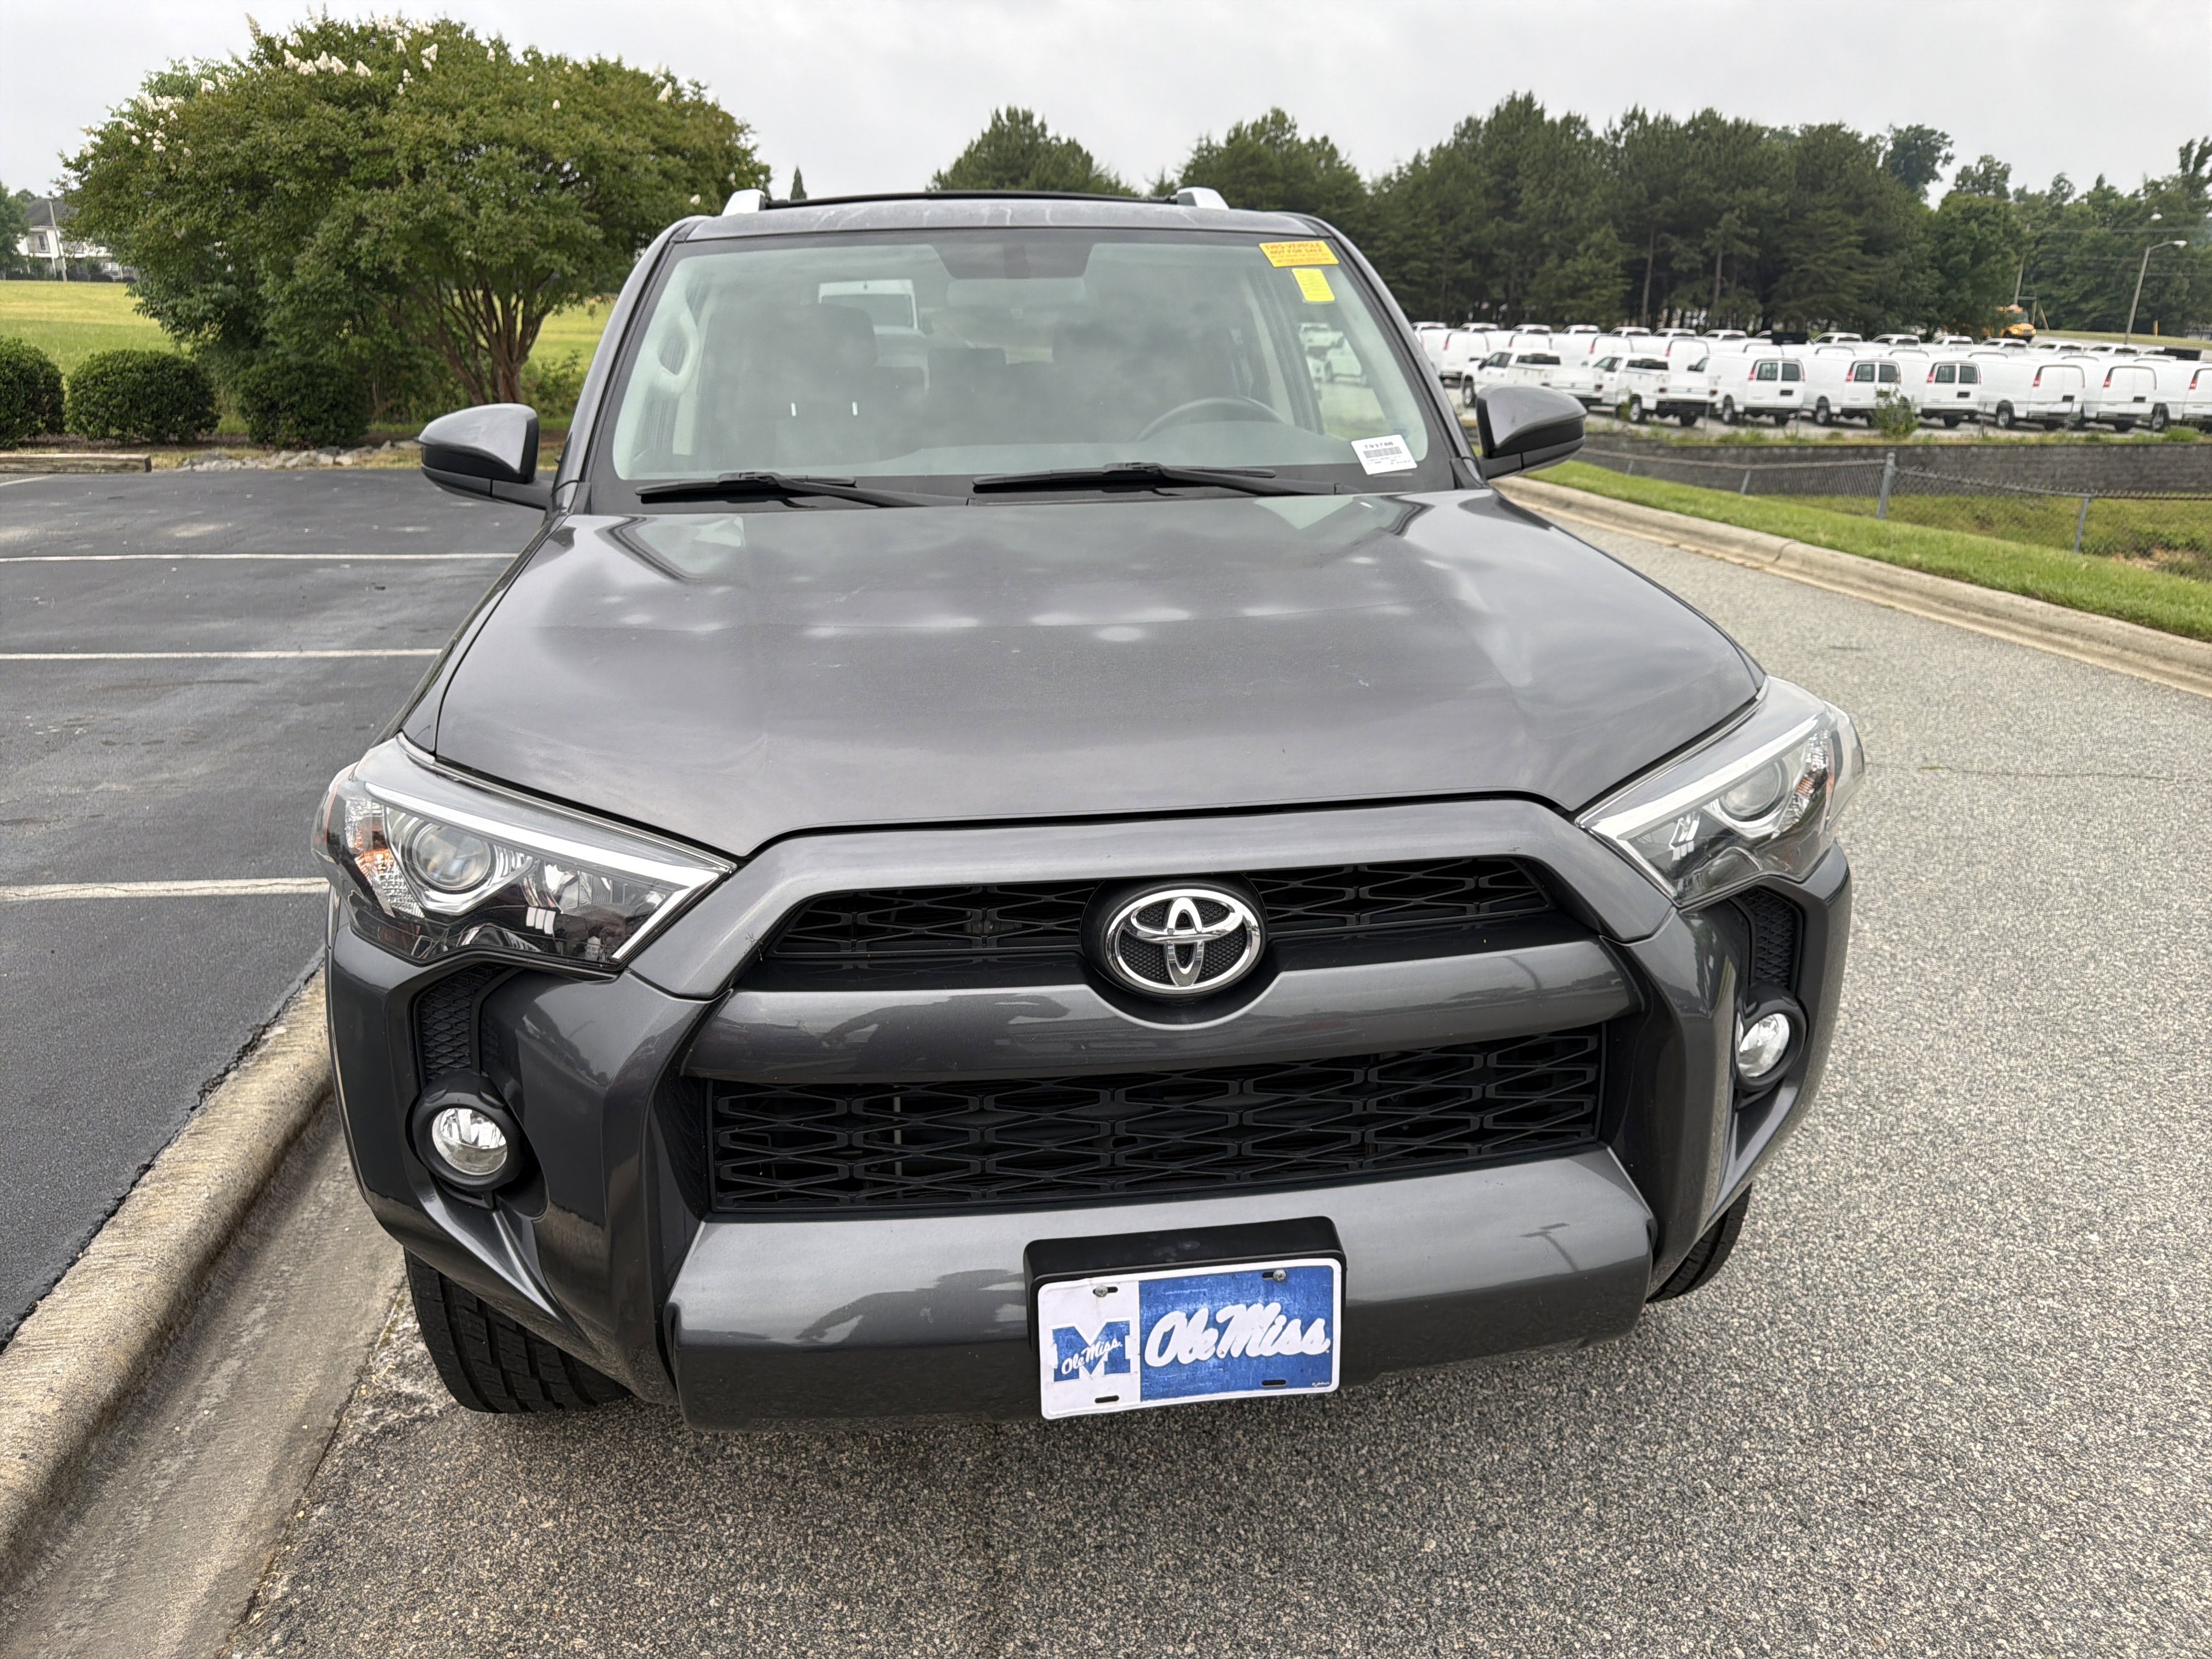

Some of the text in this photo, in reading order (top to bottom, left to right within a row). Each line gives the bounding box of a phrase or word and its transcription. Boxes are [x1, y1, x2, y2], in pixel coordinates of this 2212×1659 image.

[1061, 1338, 1121, 1375] Ole Miss
[1144, 1302, 1331, 1367] Ole Miss
